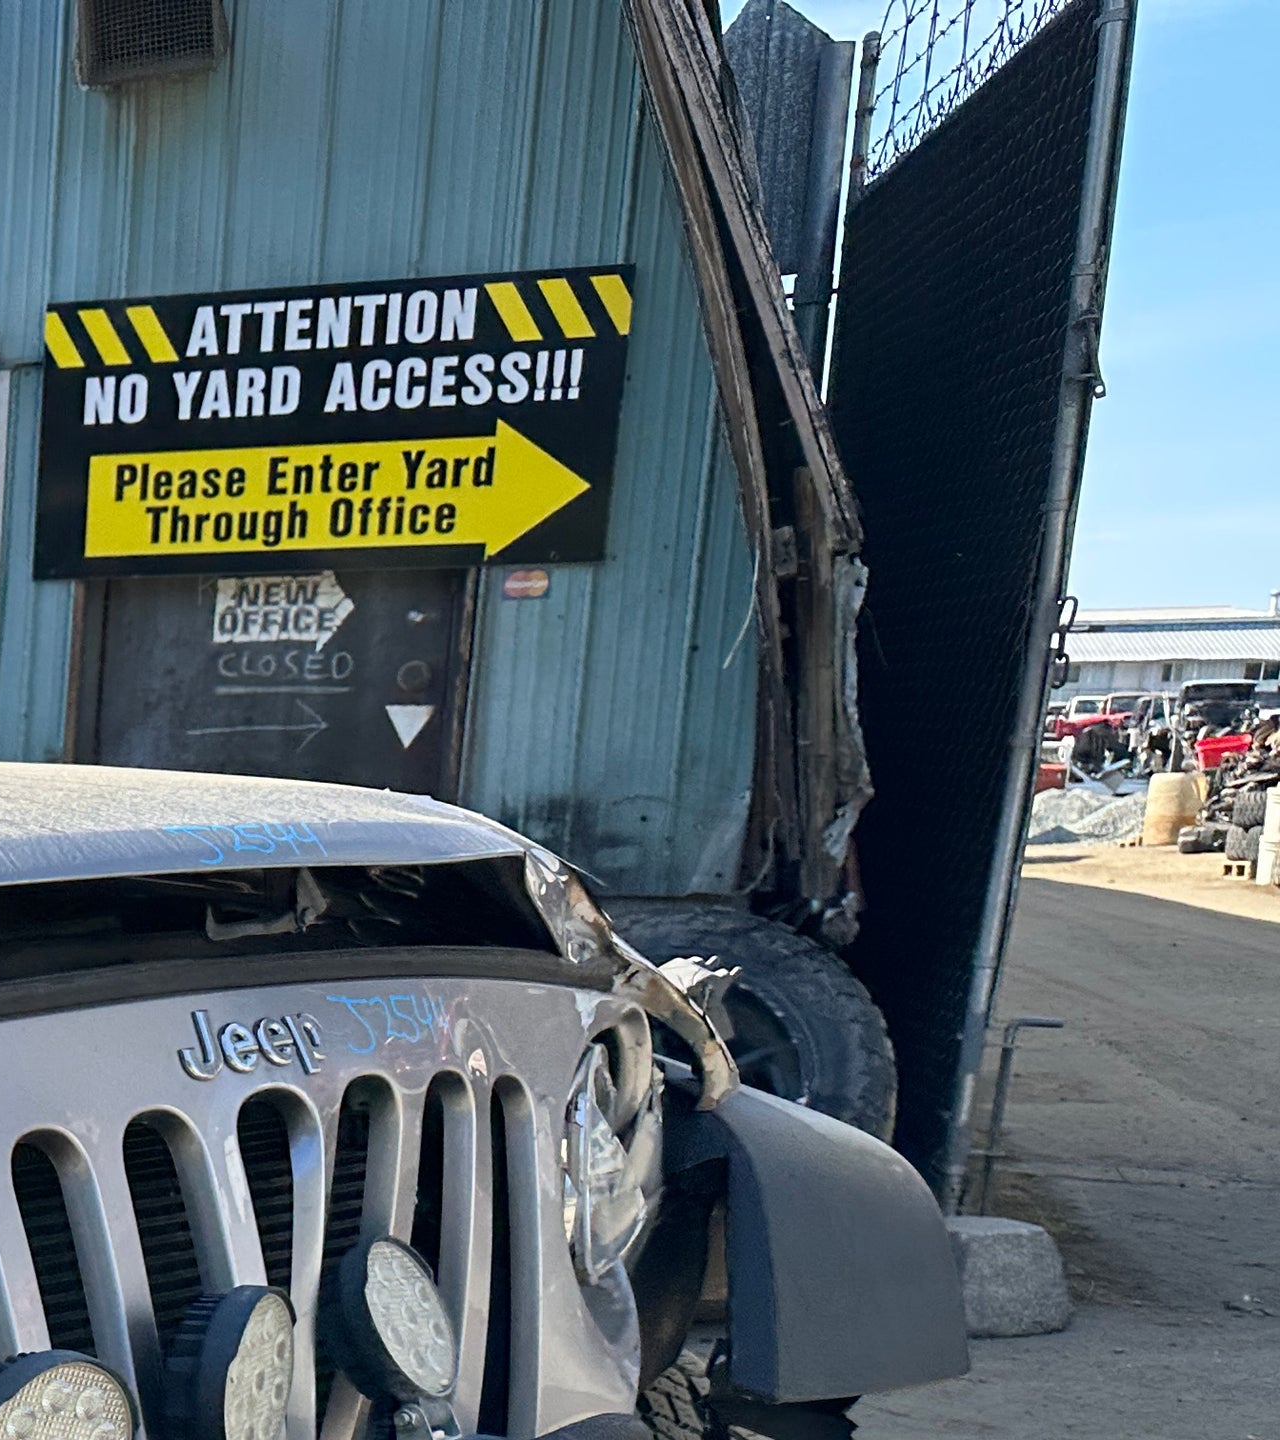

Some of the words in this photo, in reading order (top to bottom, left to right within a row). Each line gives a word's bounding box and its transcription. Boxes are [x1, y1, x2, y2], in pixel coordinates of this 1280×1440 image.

[185, 288, 478, 358] ATTENTION
[83, 374, 149, 426] NO
[172, 365, 302, 422] YARD
[323, 348, 584, 415] ACCESS!!!
[114, 463, 247, 503] Please
[267, 454, 381, 496] Enter
[402, 446, 497, 490] Yard
[145, 503, 308, 548] Through
[329, 495, 457, 537] Office
[218, 605, 338, 635] OFFICE
[237, 581, 318, 607] NEW
[218, 650, 354, 681] CLOSED
[162, 822, 329, 866] J2544
[178, 1010, 326, 1081] Jeep
[326, 993, 457, 1055] J2544
